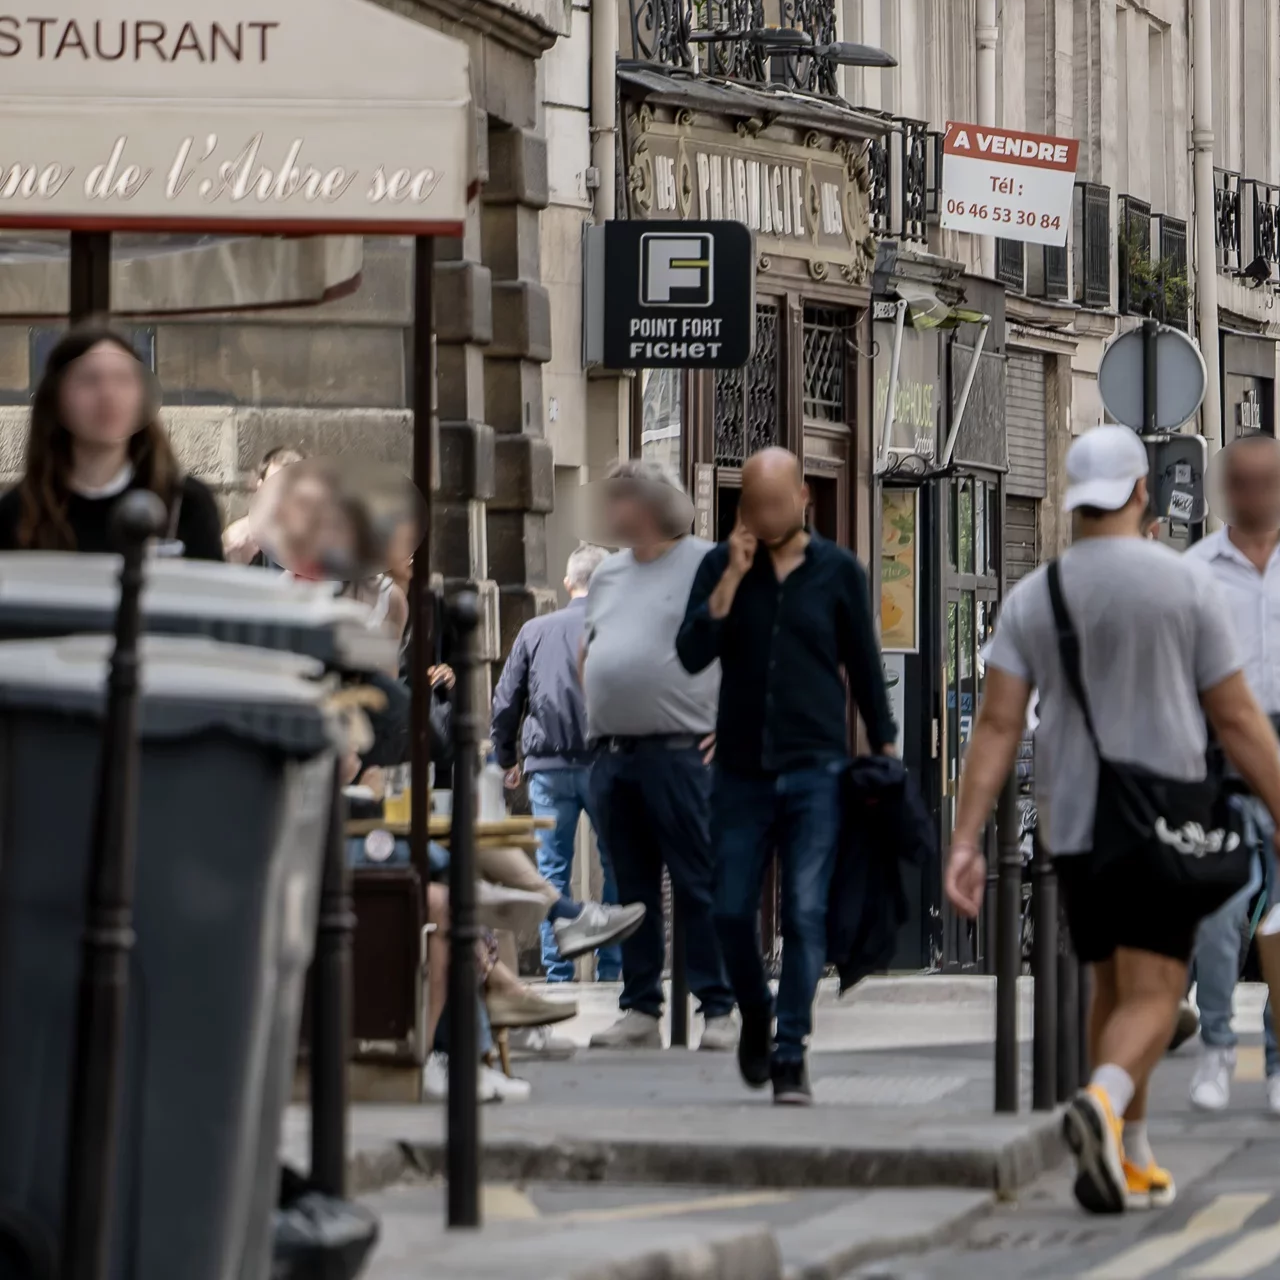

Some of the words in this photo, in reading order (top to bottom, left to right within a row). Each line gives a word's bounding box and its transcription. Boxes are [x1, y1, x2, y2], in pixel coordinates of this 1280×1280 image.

[953, 131, 971, 150] A
[976, 133, 1069, 163] VENDRE
[84, 135, 153, 200] de
[366, 164, 445, 203] sec
[696, 152, 805, 236] PHARMACIE
[947, 199, 965, 216] 06
[968, 203, 988, 219] 46
[992, 207, 1011, 223] 53
[1016, 210, 1036, 226] 30
[1040, 214, 1061, 230] 84
[630, 319, 677, 337] POINT
[682, 319, 722, 337] FORT
